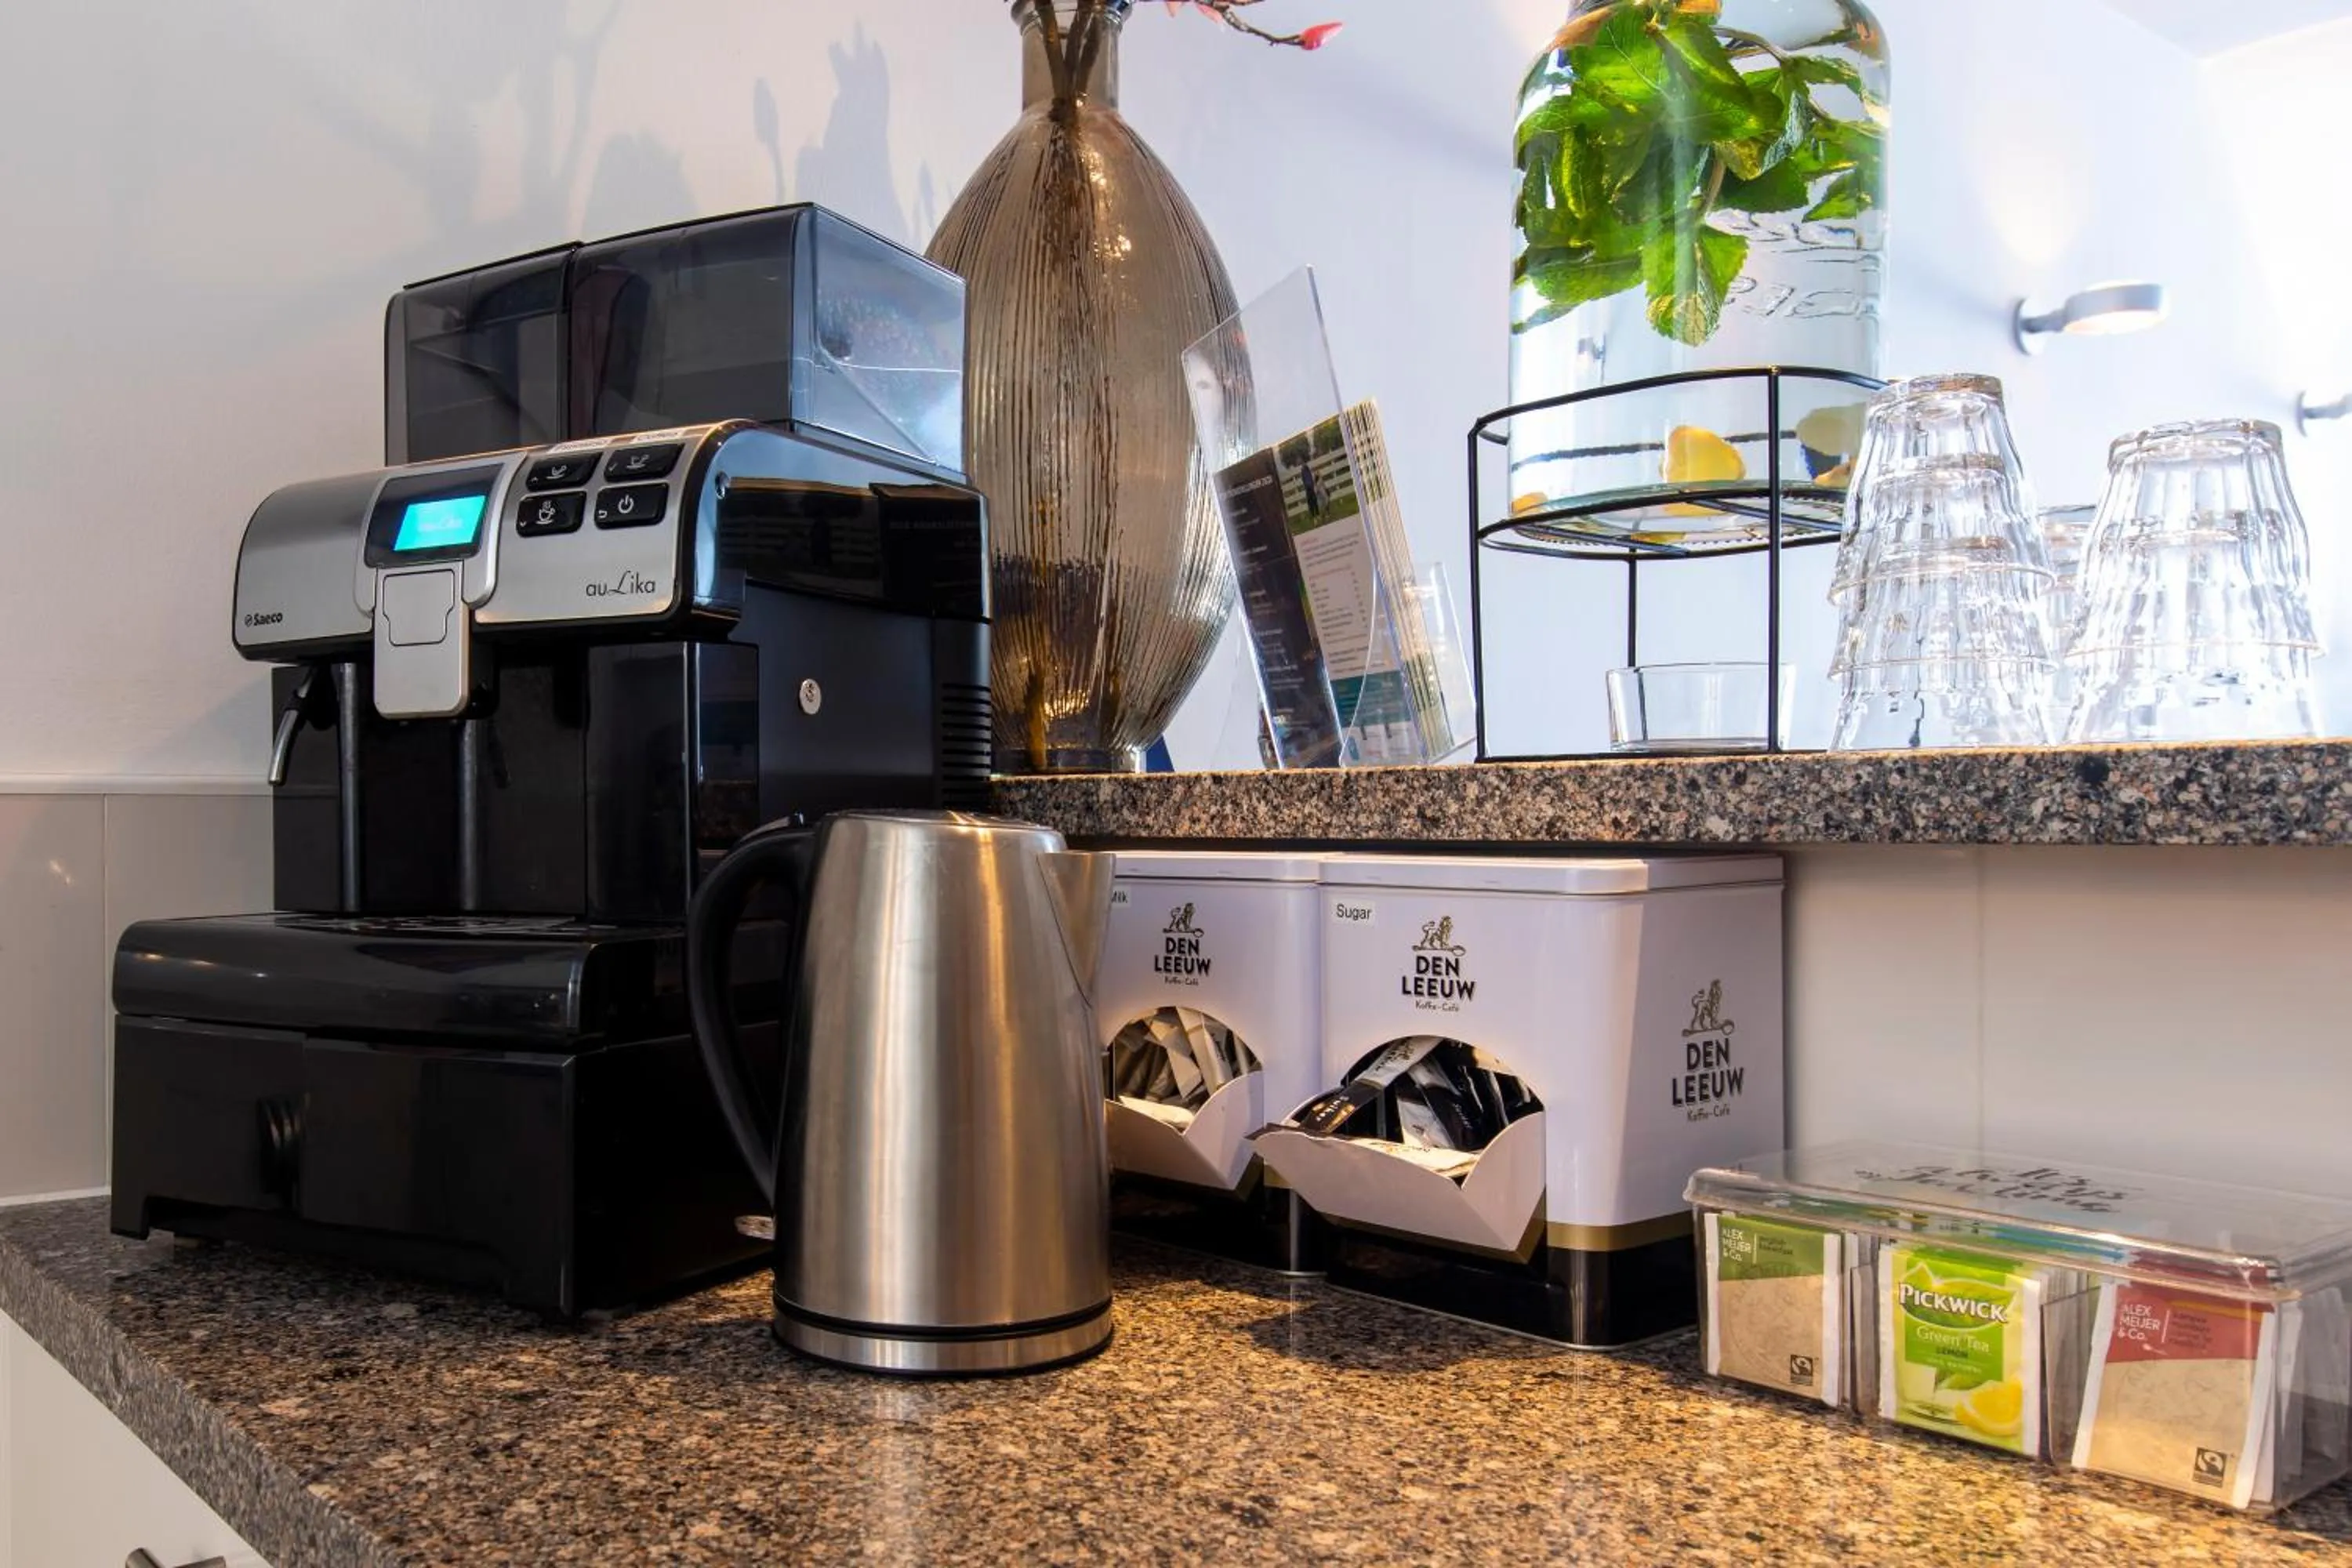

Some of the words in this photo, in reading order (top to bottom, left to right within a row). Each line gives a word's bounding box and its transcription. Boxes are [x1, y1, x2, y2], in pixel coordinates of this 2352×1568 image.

[253, 612, 283, 626] Saeco
[1336, 903, 1372, 921] Sugar
[1165, 937, 1200, 956] DEN
[1154, 954, 1211, 977] LEEUW
[1416, 955, 1461, 977] DEN
[1402, 975, 1476, 1001] LEEUW
[1686, 1037, 1730, 1070] DEN
[1671, 1066, 1744, 1106] LEEUW
[1722, 1229, 1744, 1241] ALEX
[1899, 1283, 2008, 1323] PICKWICK
[2121, 1304, 2152, 1316] ALEX
[2120, 1316, 2161, 1330] MEIJER
[1916, 1325, 1961, 1347] Green
[1965, 1334, 1991, 1353] Tea
